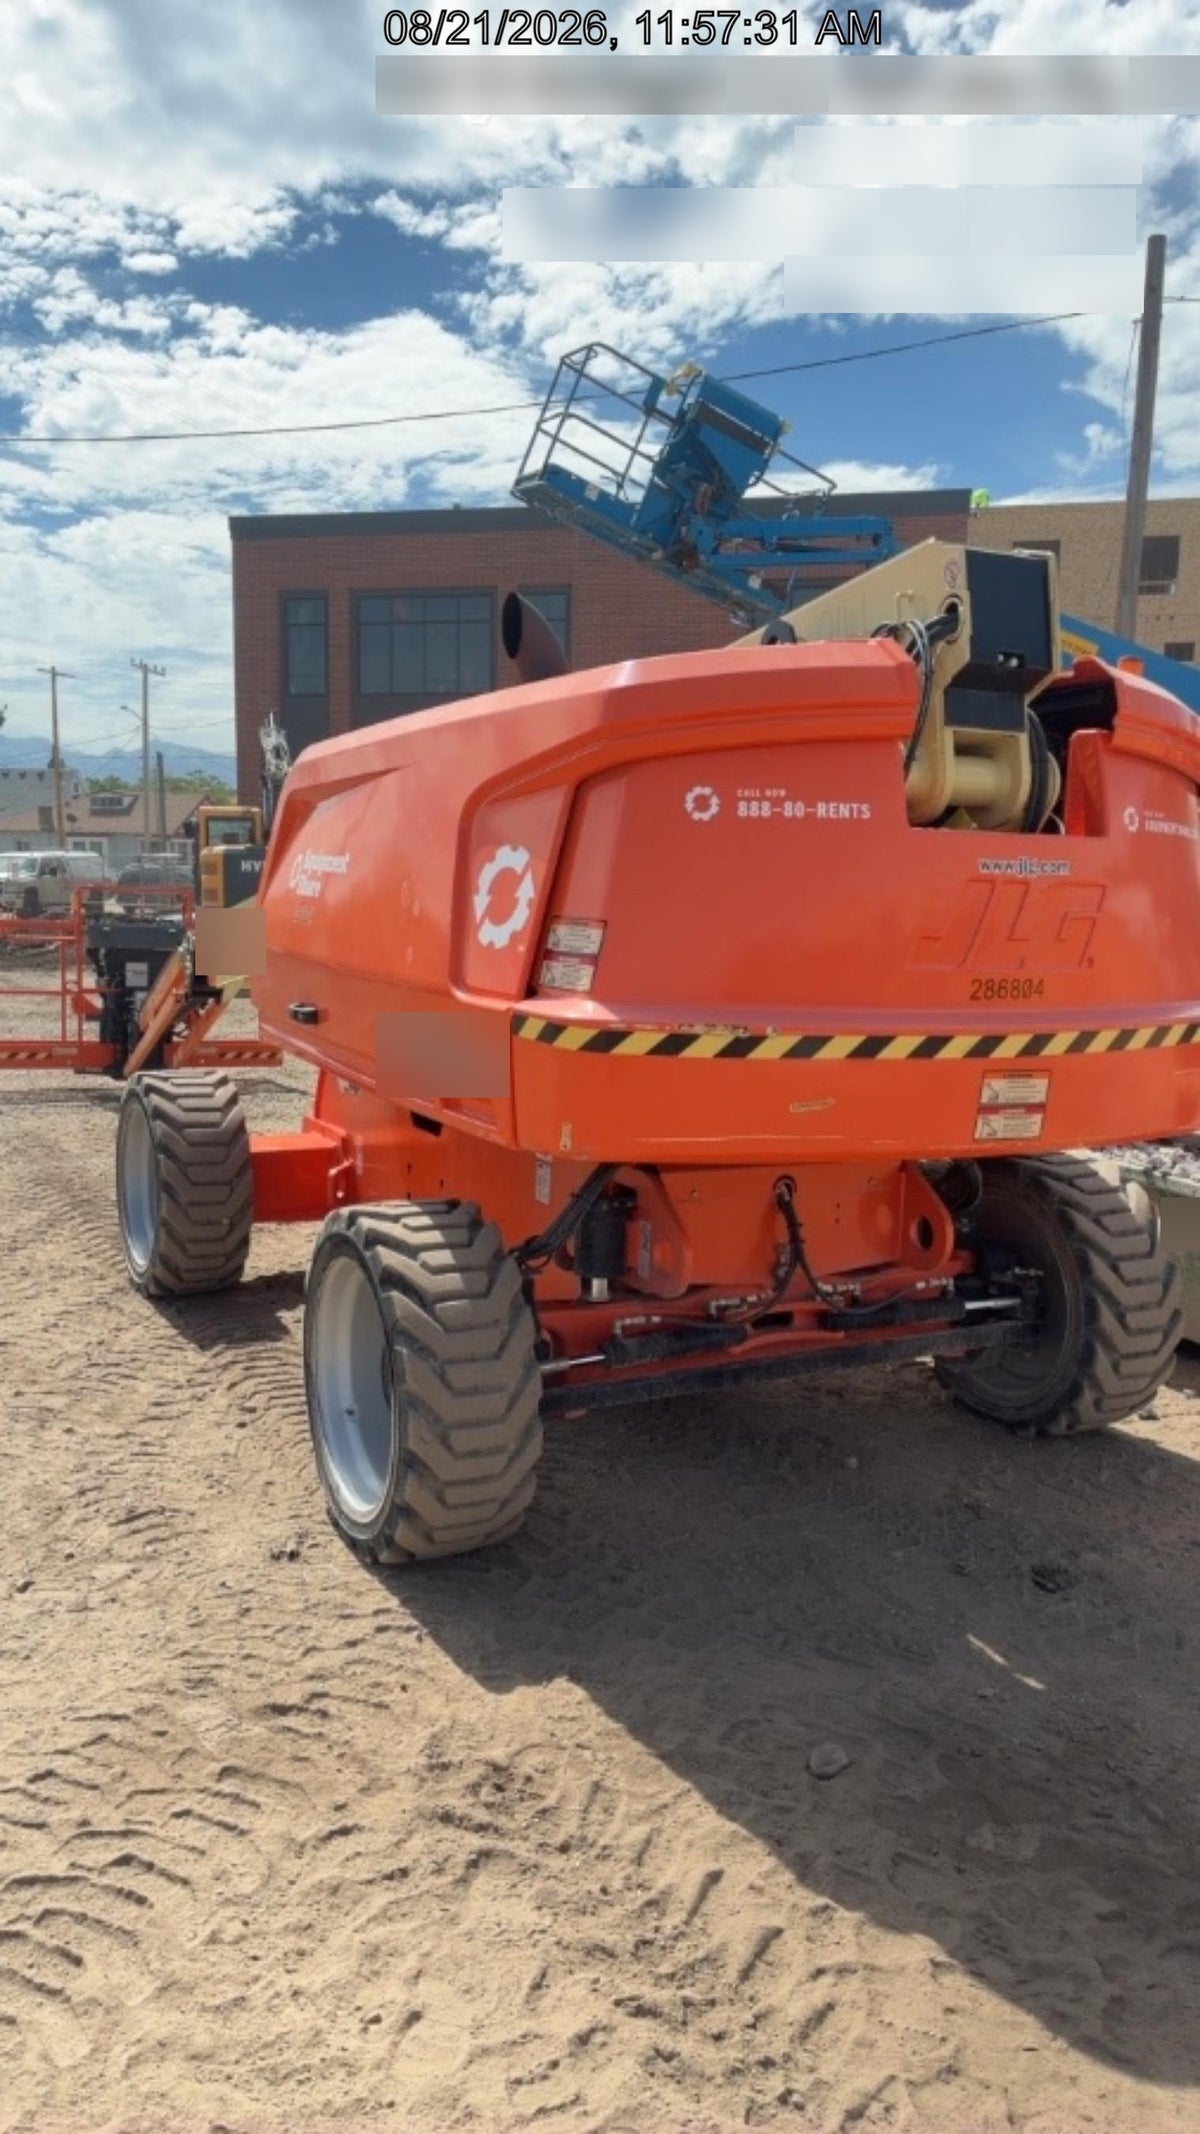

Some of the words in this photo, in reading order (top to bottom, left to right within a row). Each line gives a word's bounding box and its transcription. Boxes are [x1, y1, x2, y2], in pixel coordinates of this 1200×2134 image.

[737, 789, 762, 798] CALL
[765, 789, 787, 798] NOW
[737, 801, 872, 819] 888-80-RENTS
[241, 860, 264, 872] HY
[977, 857, 1070, 877] www.jlg.com
[969, 978, 1045, 1001] 286804
